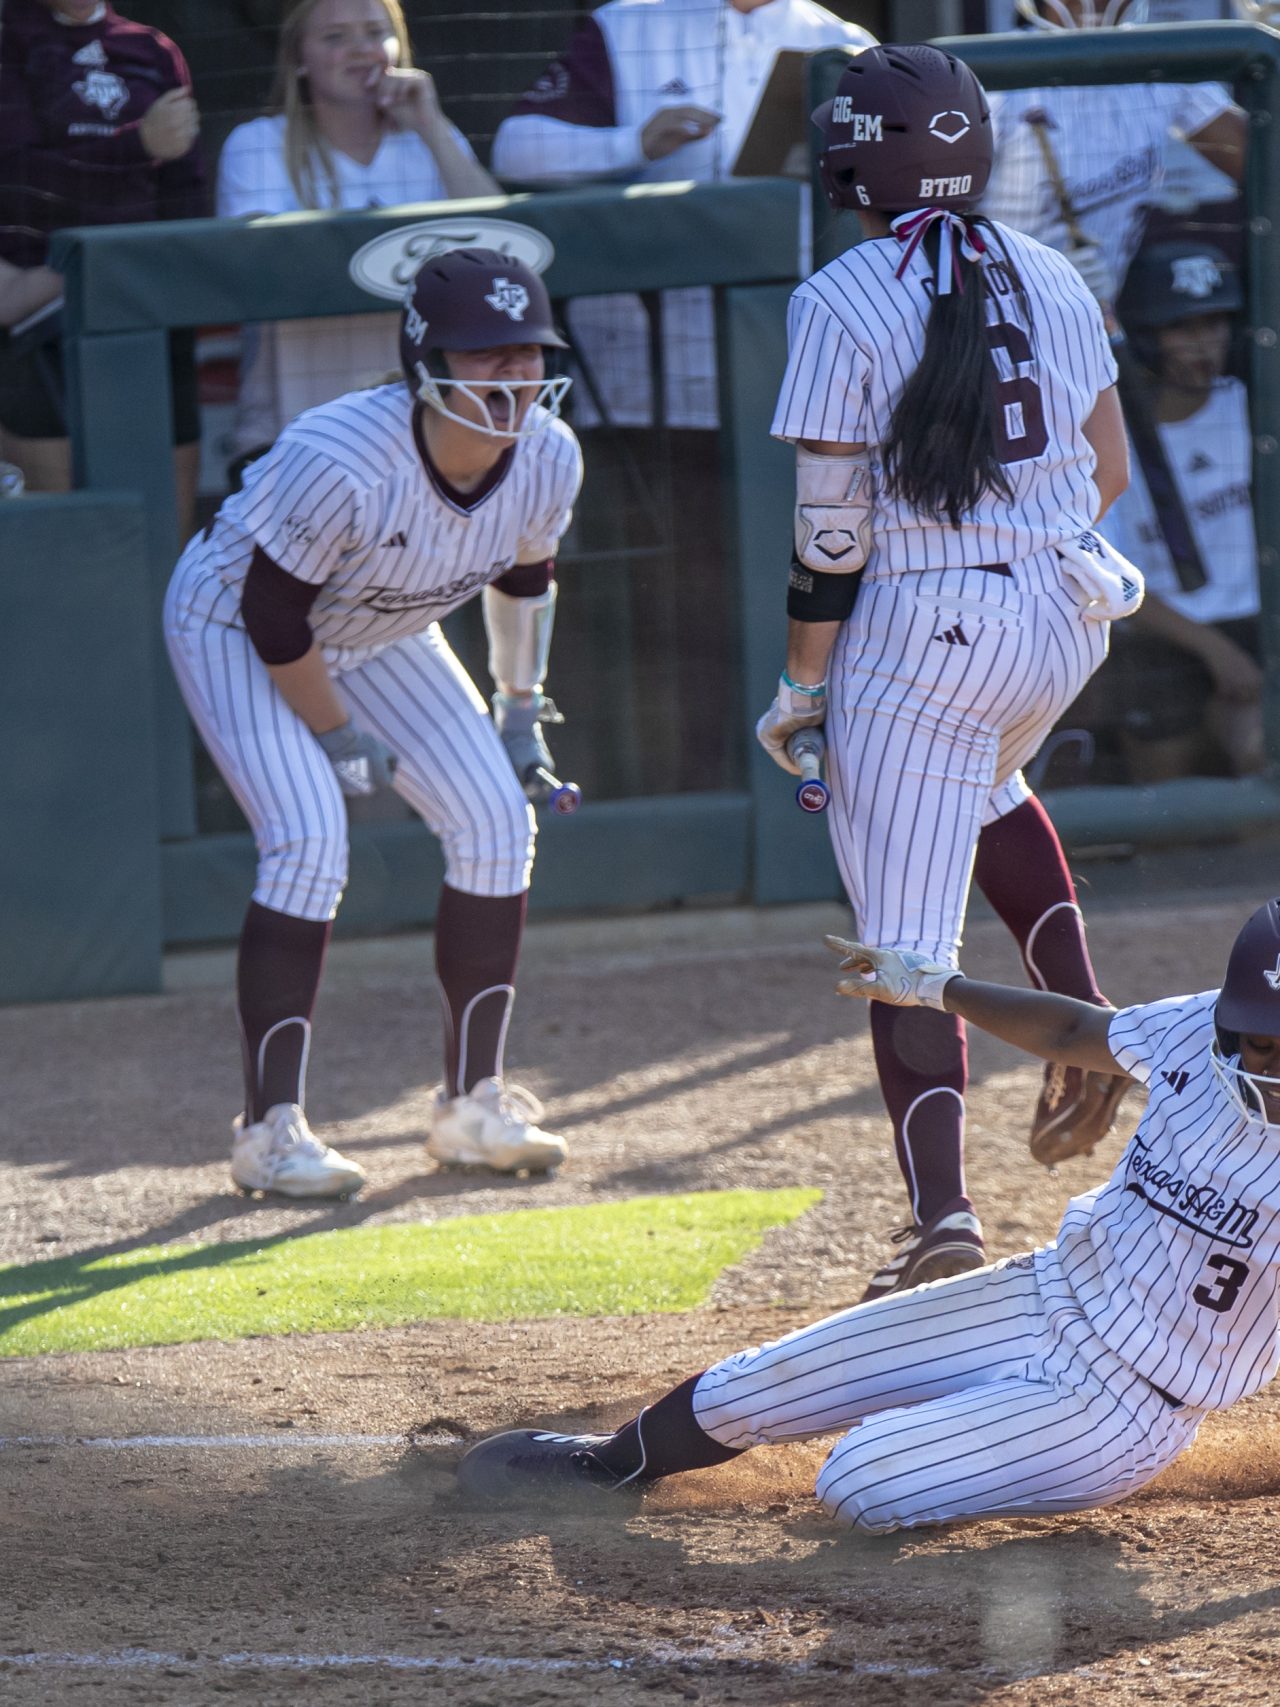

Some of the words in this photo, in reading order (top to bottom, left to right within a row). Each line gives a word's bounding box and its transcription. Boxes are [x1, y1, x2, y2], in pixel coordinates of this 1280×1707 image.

[856, 185, 871, 206] 6
[918, 175, 973, 198] BTHO
[984, 321, 1050, 464] 6
[1123, 1134, 1185, 1198] Texas
[1178, 1184, 1260, 1237] A&M
[1192, 1252, 1250, 1314] 3
